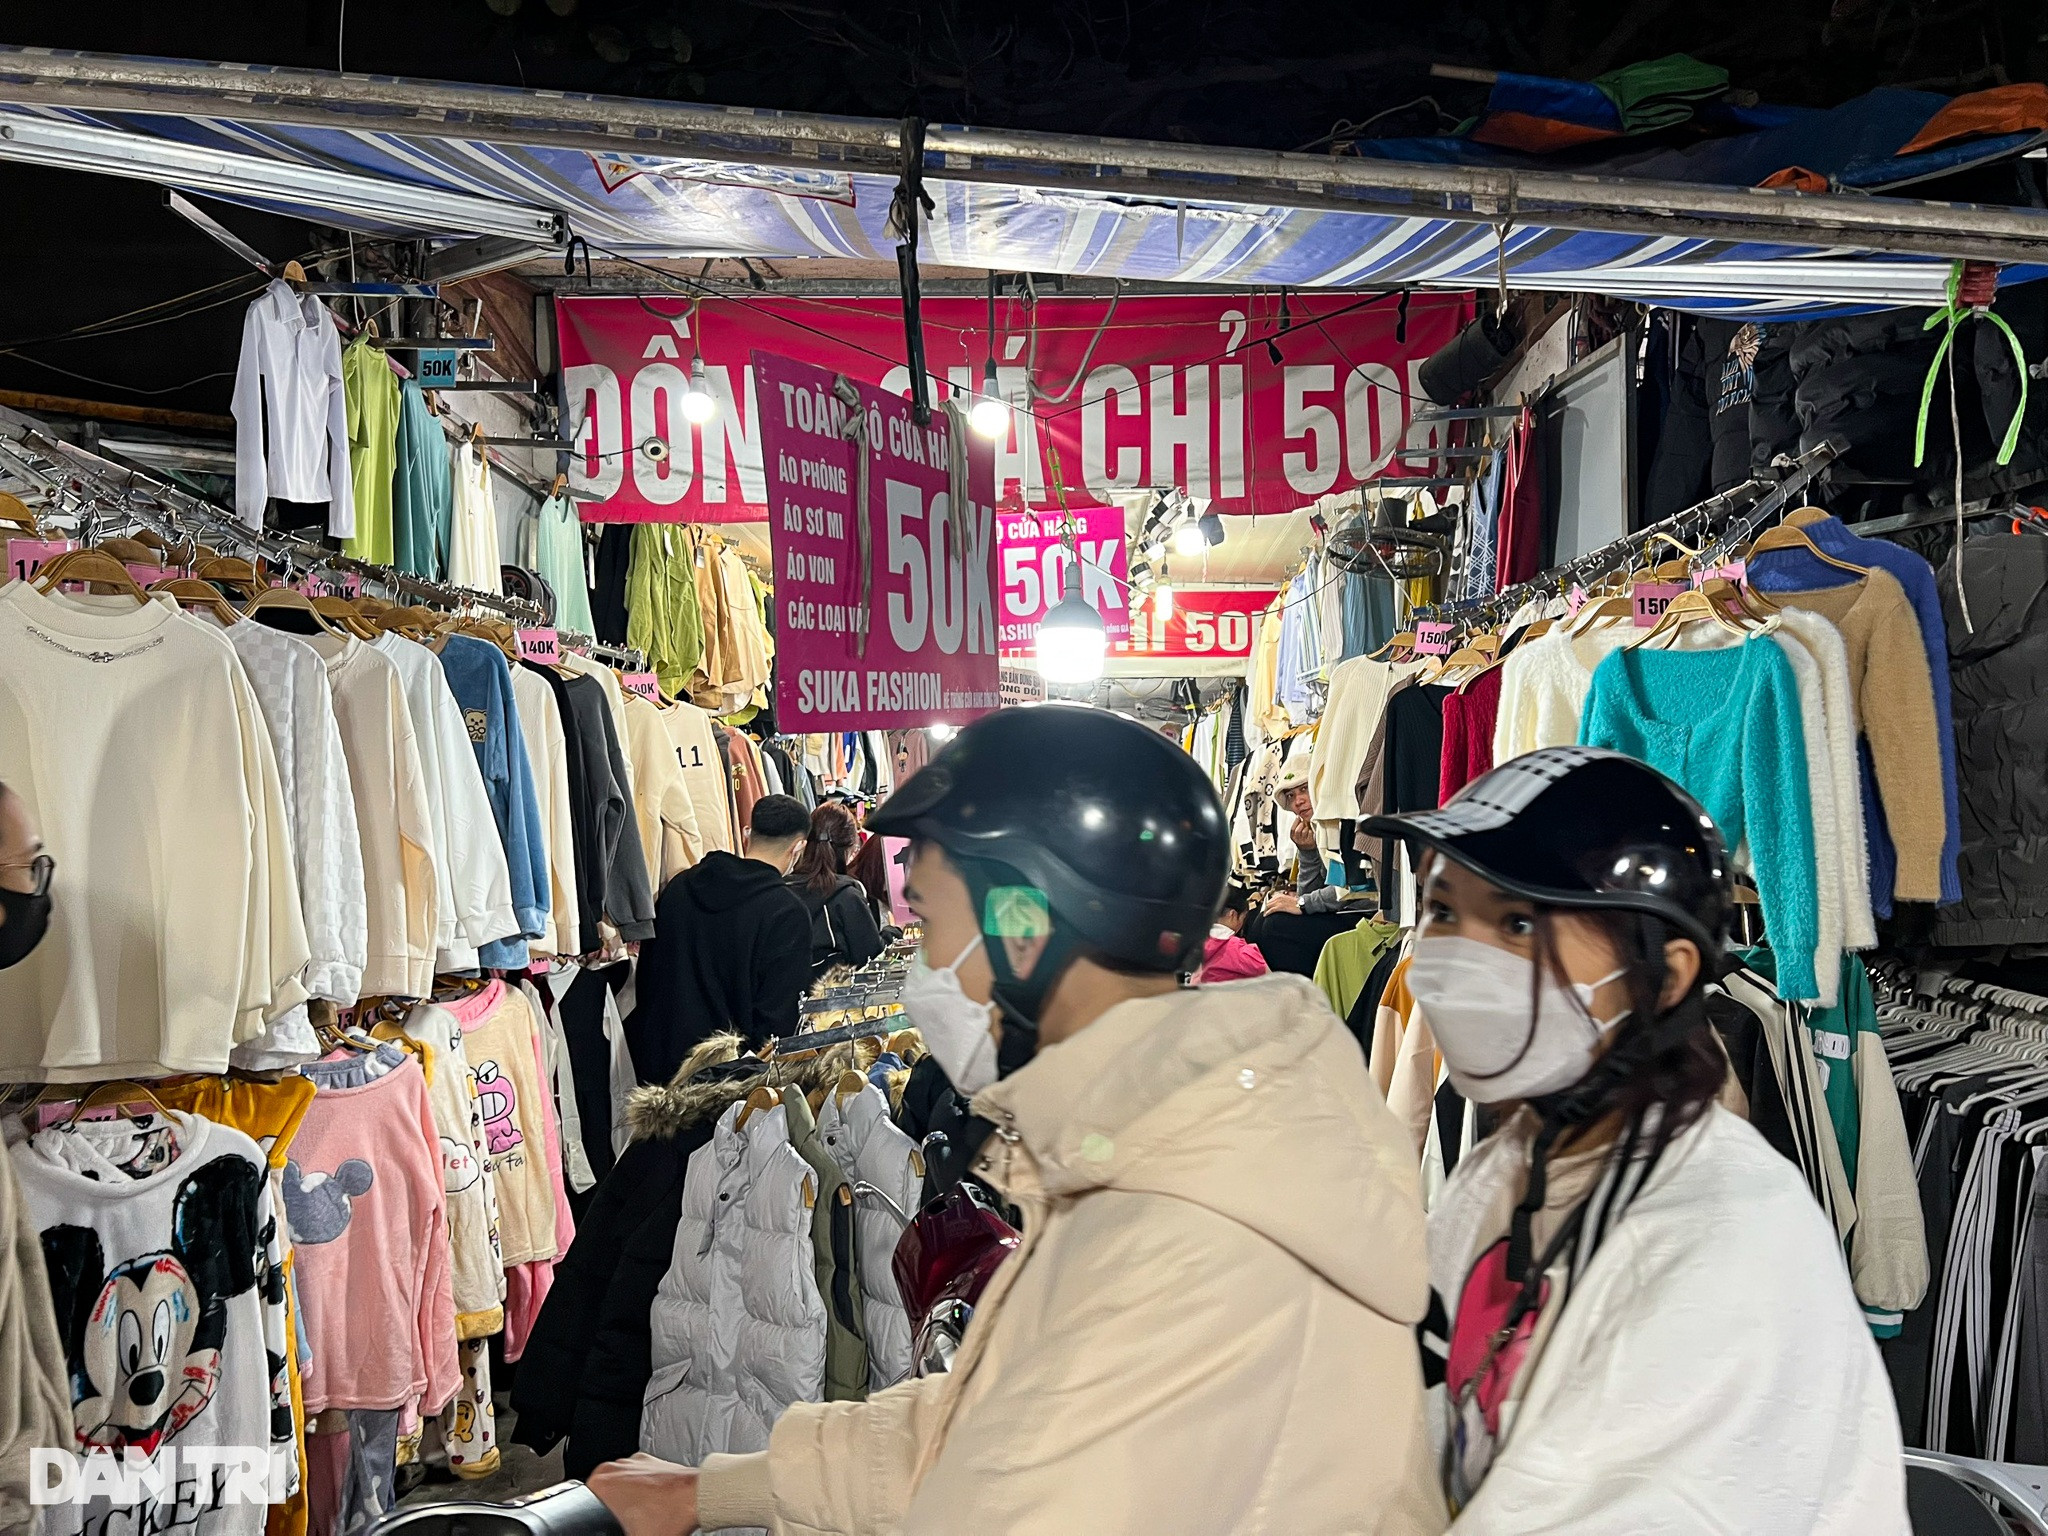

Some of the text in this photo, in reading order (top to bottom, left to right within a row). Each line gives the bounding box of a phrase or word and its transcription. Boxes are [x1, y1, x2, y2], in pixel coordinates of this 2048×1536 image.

[422, 359, 452, 377] 50K
[564, 316, 768, 506] ĐỒN
[1081, 310, 1246, 502] CHỈ
[779, 381, 849, 441] TOÀN
[888, 407, 925, 466] CỬA
[926, 425, 969, 480] HÀ
[779, 448, 847, 495] ÁO PHÔNG
[783, 496, 844, 540] ÁO SƠ MI
[786, 546, 835, 586] ÁO VON
[885, 478, 996, 656] 50K
[1003, 538, 1124, 617] 50K
[788, 595, 815, 631] CÁC
[818, 603, 846, 638] LOẠI
[1637, 596, 1674, 615] 150
[521, 640, 555, 655] 140K
[627, 682, 655, 695] 40K
[798, 669, 861, 713] SUKA
[866, 671, 942, 711] FASHION
